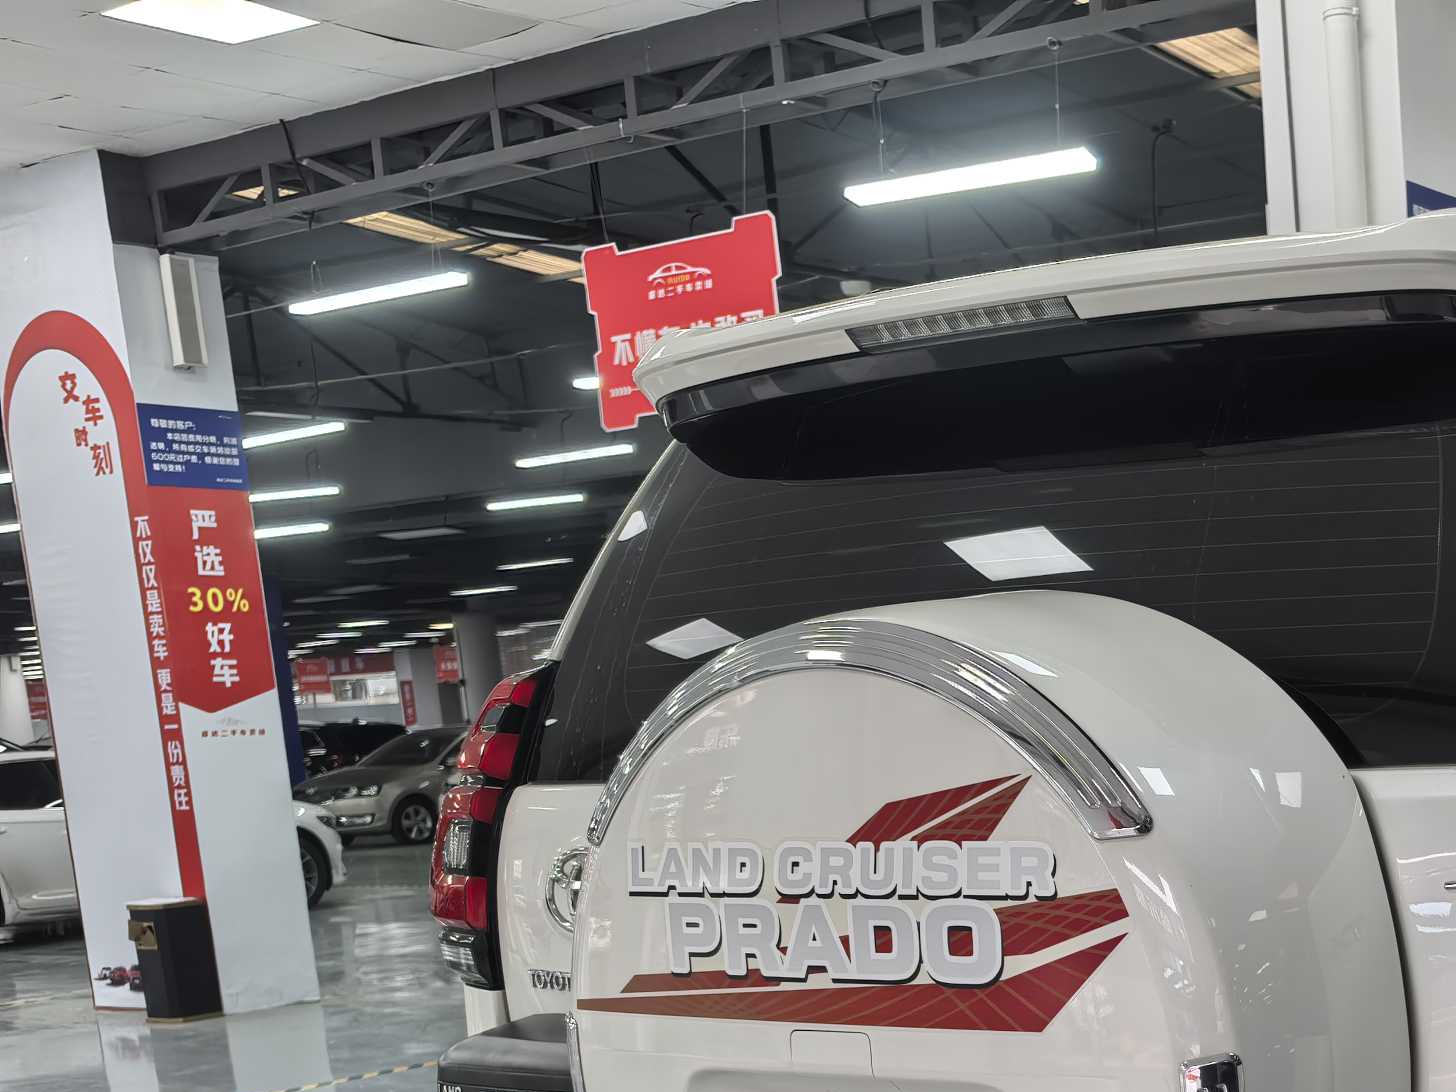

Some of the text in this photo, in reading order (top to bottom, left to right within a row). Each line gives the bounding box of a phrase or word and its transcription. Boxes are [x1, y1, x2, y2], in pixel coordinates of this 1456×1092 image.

[58, 370, 114, 477] 交车时刻
[187, 587, 249, 613] 30%
[627, 840, 1057, 899] LAND CRUISER
[664, 899, 1004, 987] PRADO
